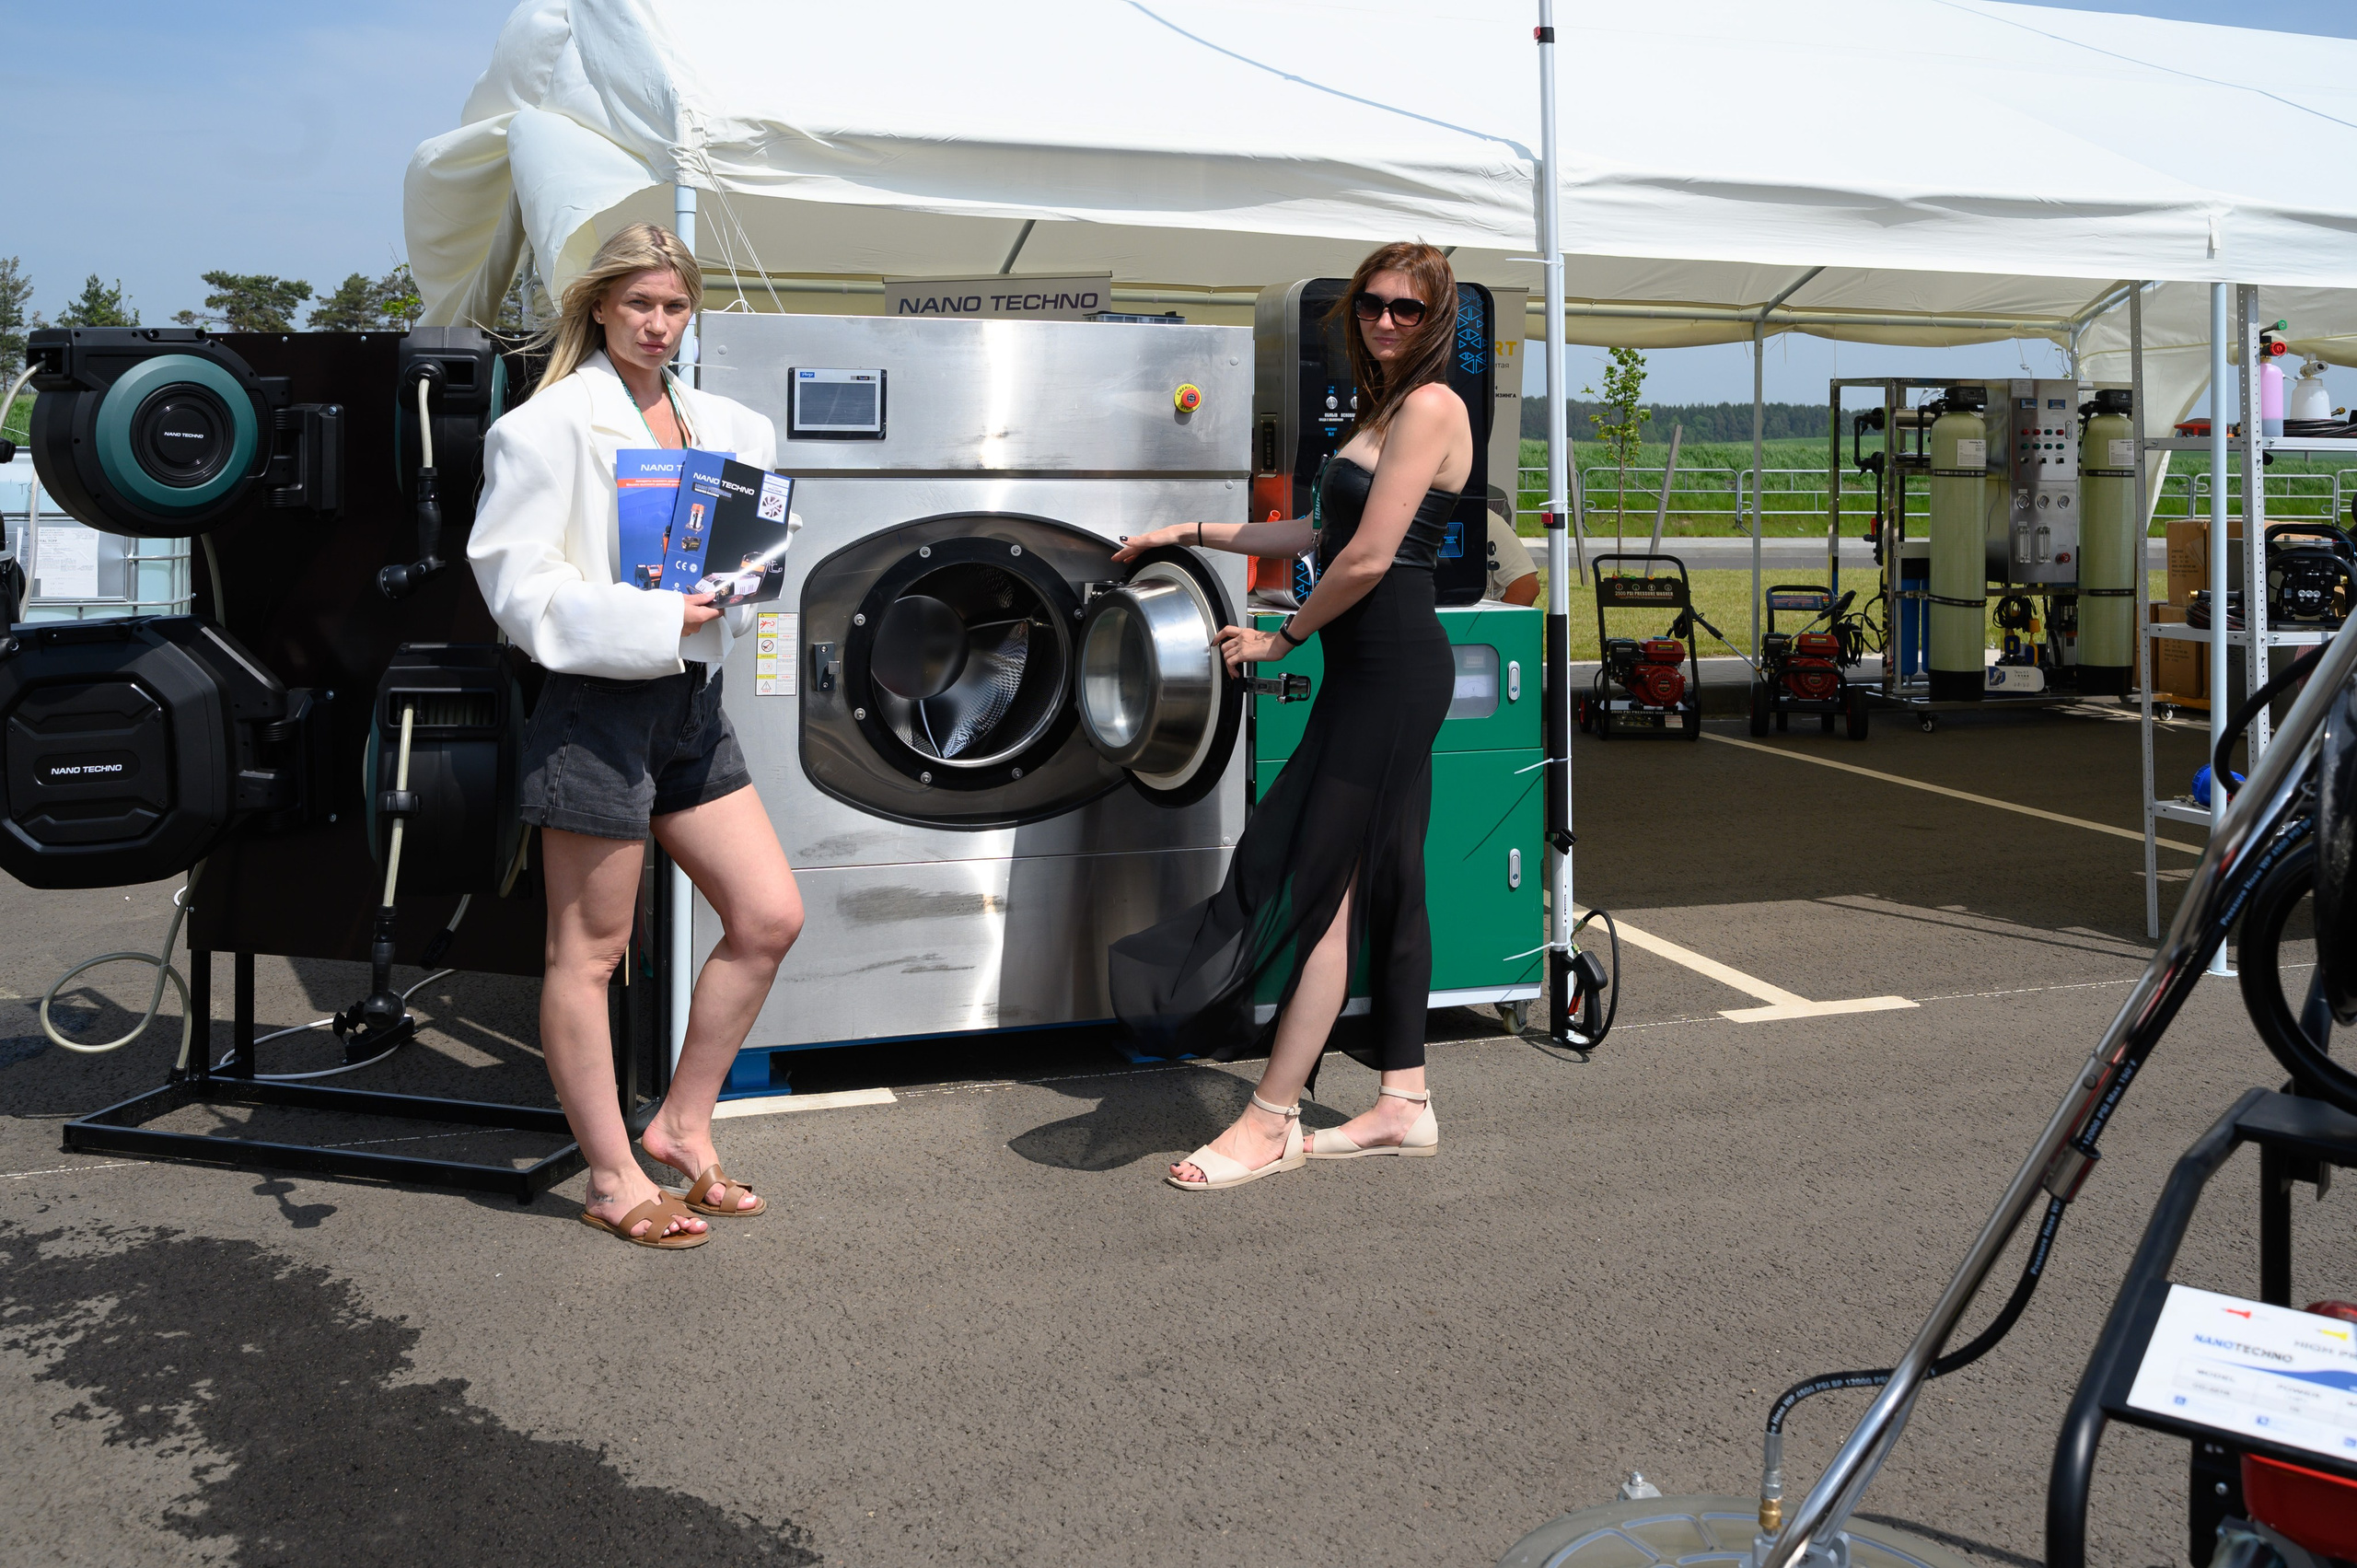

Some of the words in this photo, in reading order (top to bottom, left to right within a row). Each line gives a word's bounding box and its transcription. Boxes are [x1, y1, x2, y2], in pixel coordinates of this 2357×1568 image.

[899, 296, 982, 314] NANO
[990, 292, 1098, 311] TECHNO
[693, 472, 720, 485] NANO
[721, 480, 755, 496] TECHNO
[51, 767, 81, 775] NANO
[82, 764, 122, 773] TECHNO
[2220, 890, 2248, 926] Pressure
[2243, 869, 2263, 890] Hose
[2259, 855, 2273, 869] WP
[2287, 827, 2304, 840] PSI
[2083, 1119, 2102, 1146] 12000
[2097, 1103, 2111, 1120] PSI
[2106, 1086, 2122, 1104] Max
[2030, 1237, 2049, 1275] Pressure
[2042, 1214, 2056, 1237] Hose
[2194, 1333, 2293, 1363] NANOTECHNO
[1771, 1406, 1787, 1426] Hose
[1782, 1394, 1796, 1408] WP
[1795, 1386, 1816, 1399] 4500
[1815, 1382, 1830, 1391] PSI
[1832, 1379, 1843, 1388] BP
[1846, 1377, 1873, 1386] 12000
